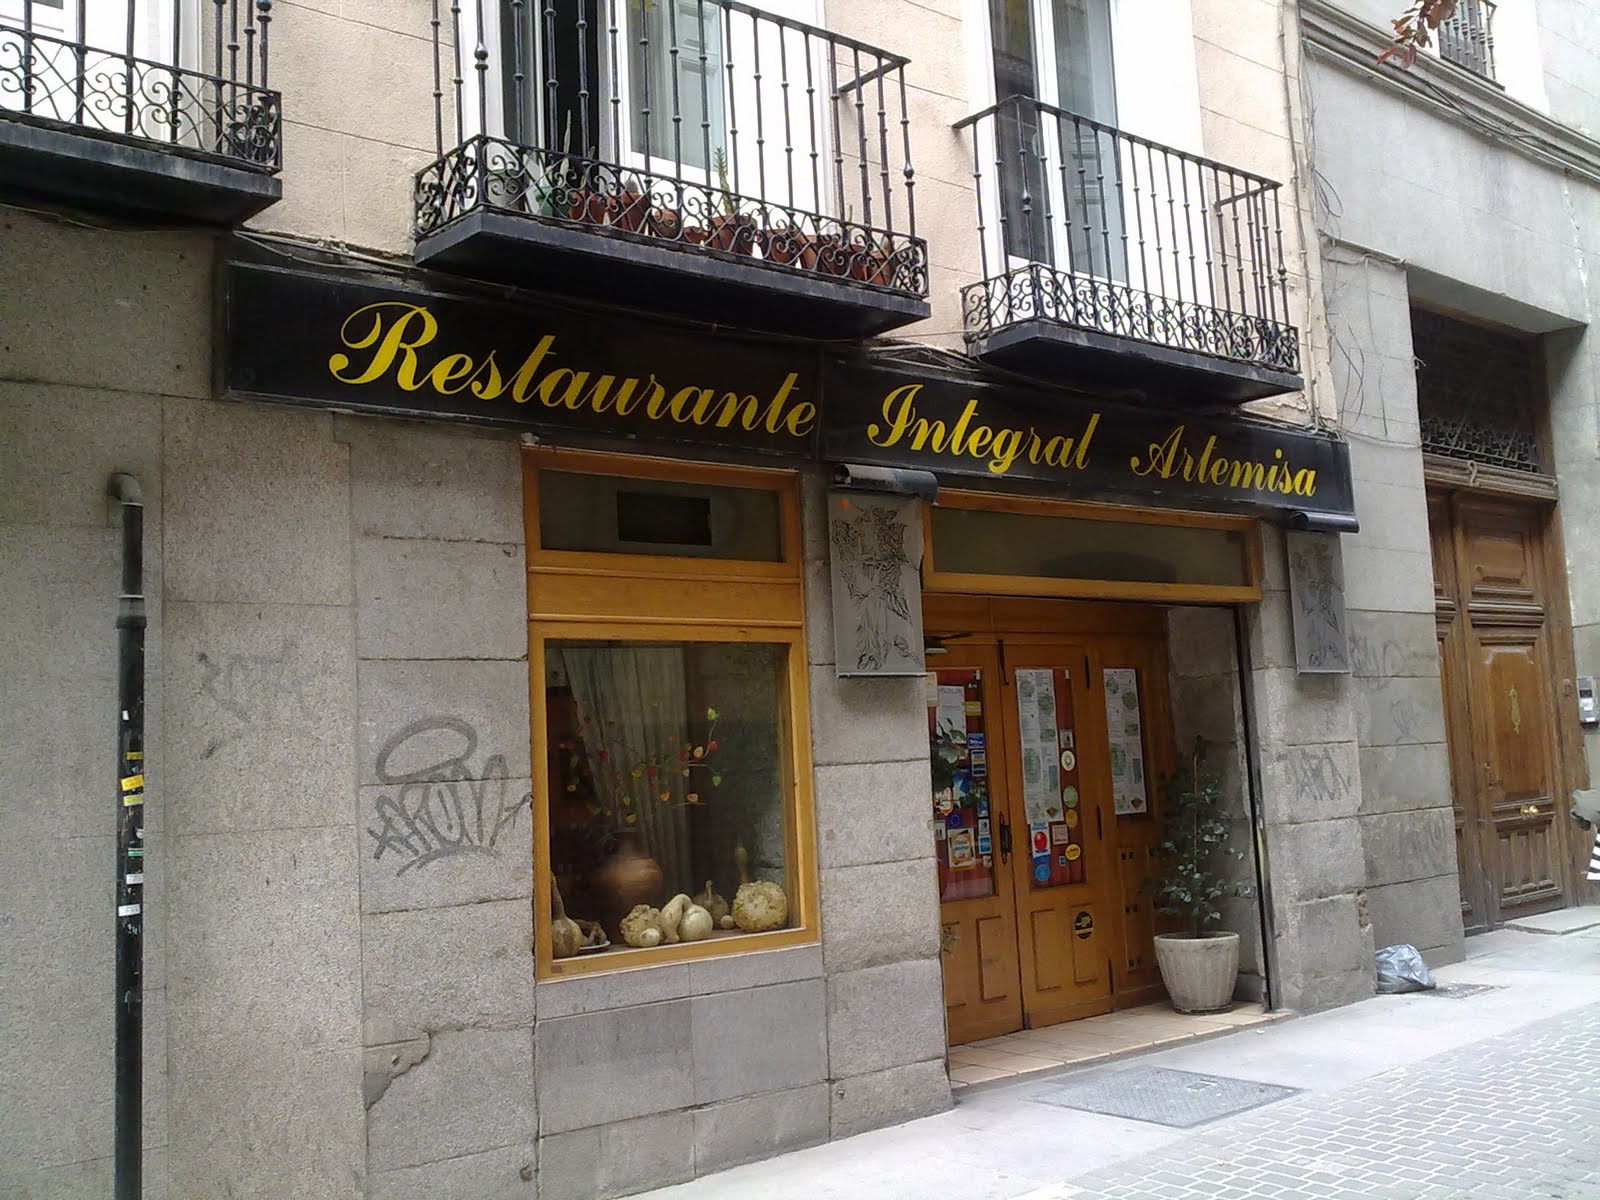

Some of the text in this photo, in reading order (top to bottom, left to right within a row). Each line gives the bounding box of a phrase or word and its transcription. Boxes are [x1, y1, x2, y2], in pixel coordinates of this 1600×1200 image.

[328, 301, 1317, 497] Restaurante Integral Artemisa
